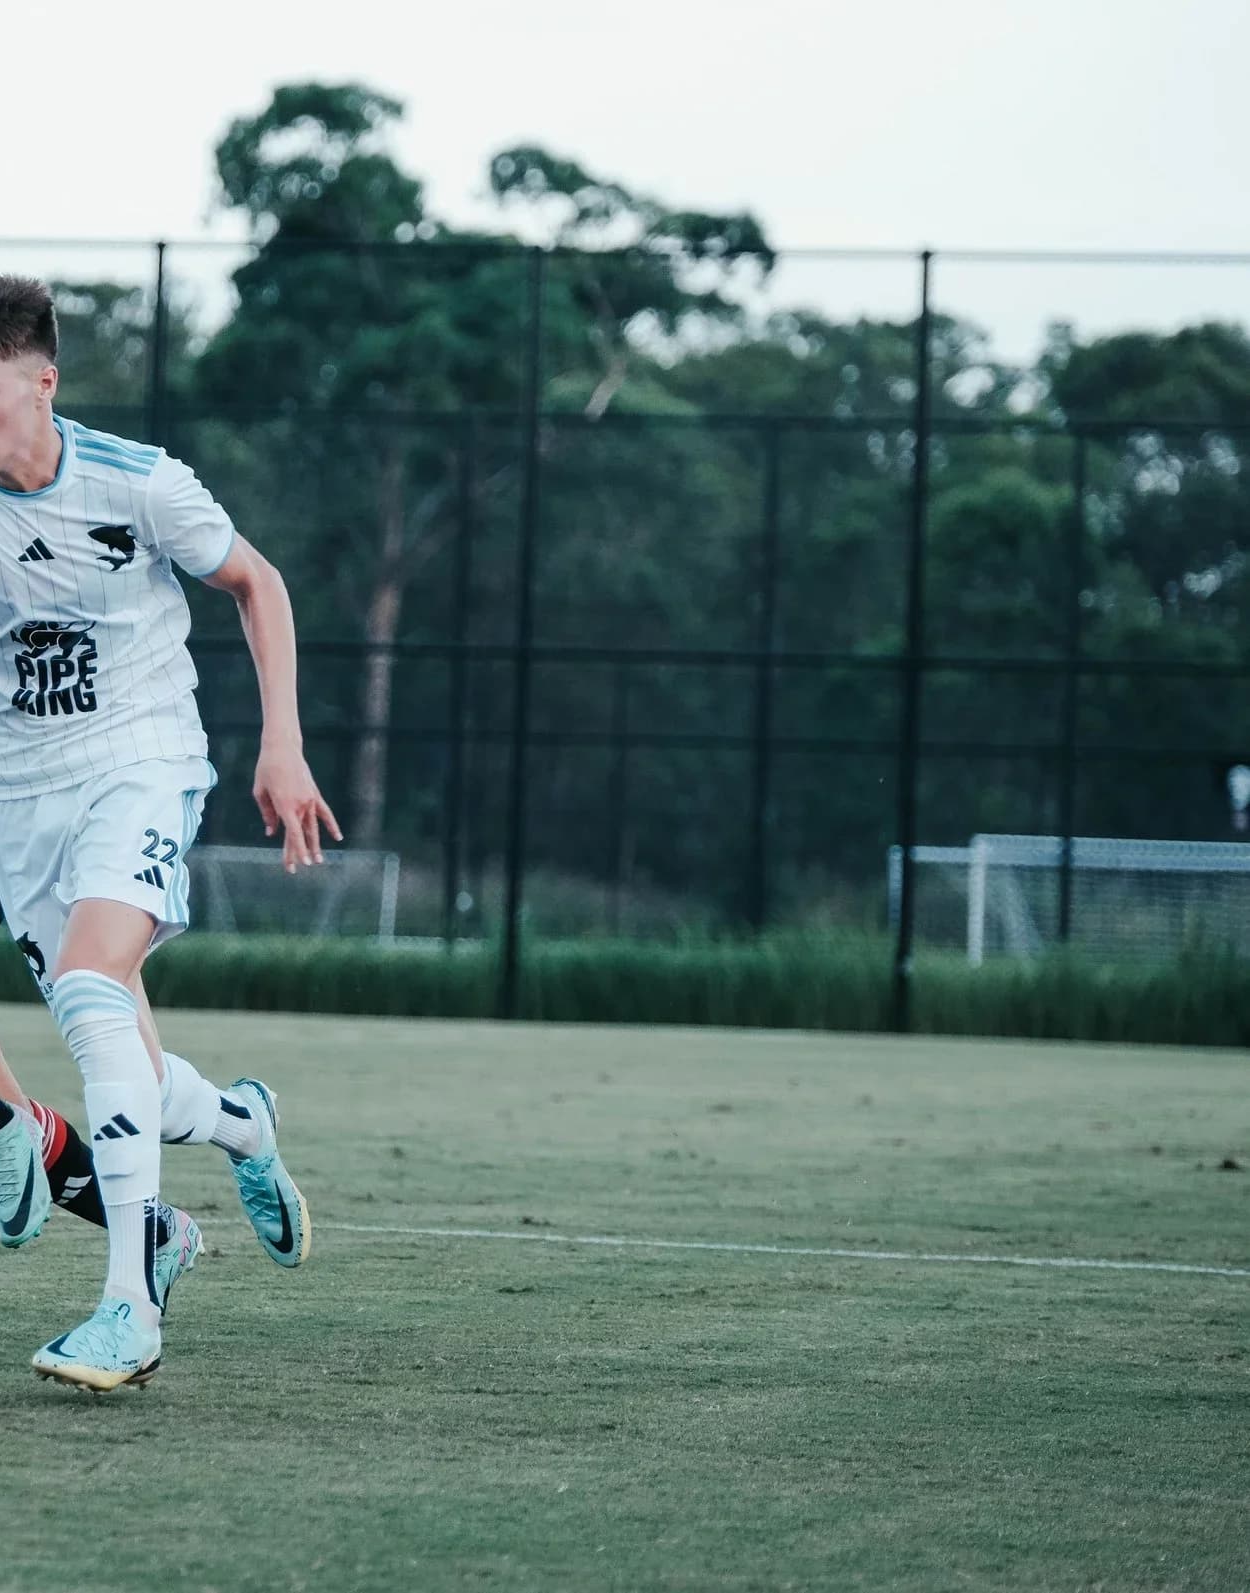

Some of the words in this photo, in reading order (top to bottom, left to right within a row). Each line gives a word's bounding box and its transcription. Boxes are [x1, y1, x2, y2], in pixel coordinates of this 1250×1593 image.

[14, 652, 98, 690] PIPE
[11, 687, 98, 717] KING
[140, 828, 179, 870] 22
